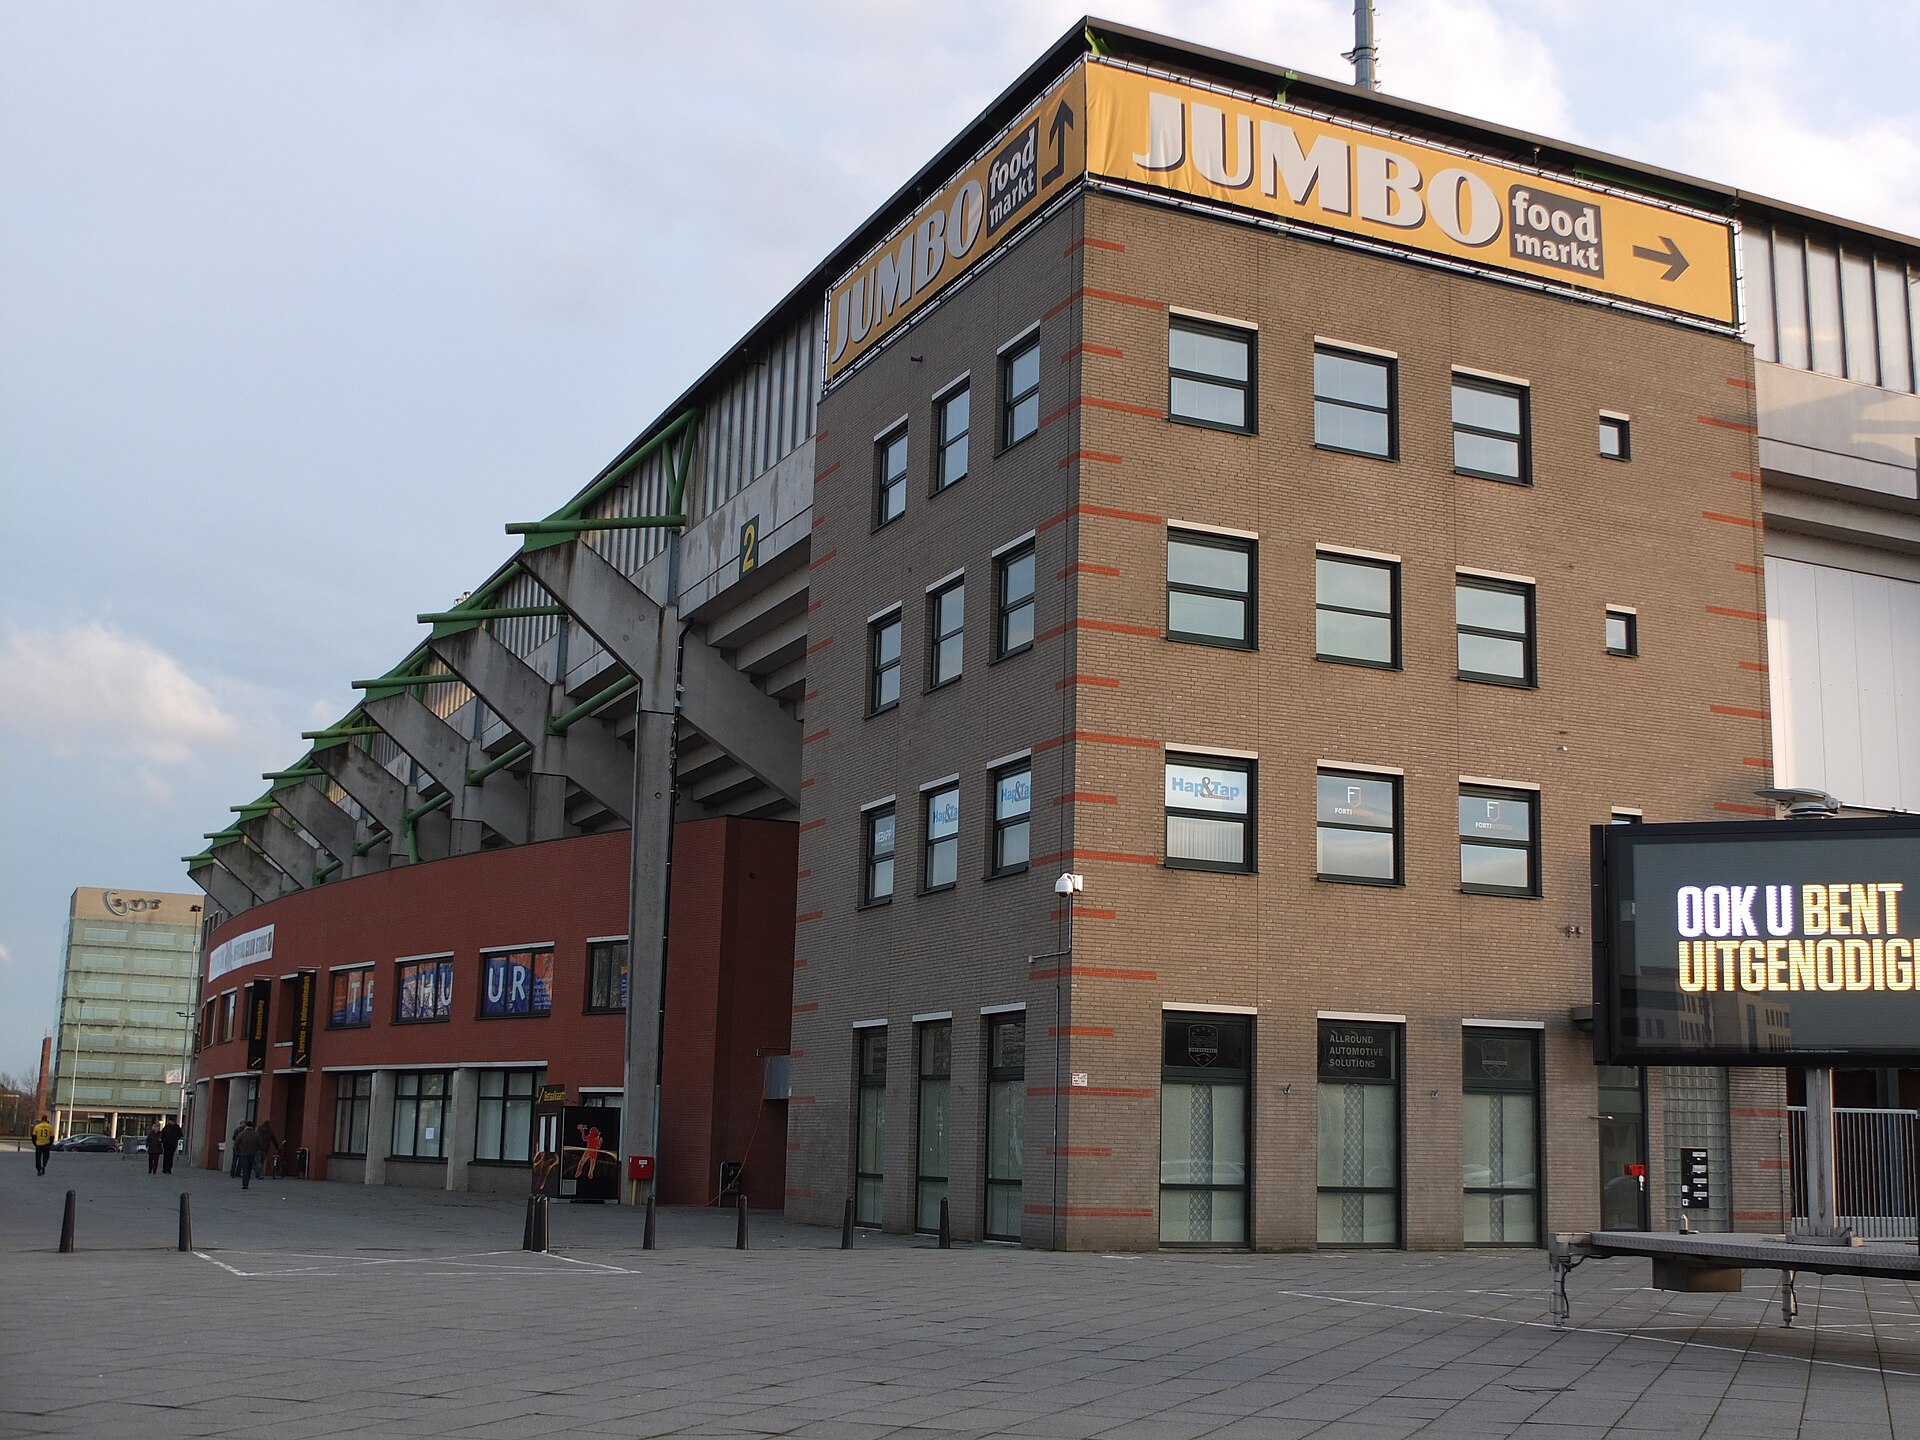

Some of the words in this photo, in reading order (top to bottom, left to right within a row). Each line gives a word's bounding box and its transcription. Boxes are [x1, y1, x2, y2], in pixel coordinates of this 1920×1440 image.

[990, 127, 1035, 200] food
[1132, 91, 1503, 247] JUMBO
[990, 168, 1034, 228] markt
[1512, 190, 1598, 244] food
[831, 179, 984, 363] JUMBO
[1514, 233, 1600, 271] markt
[742, 524, 755, 573] 2
[1001, 780, 1030, 803] Hap&Ta
[1171, 776, 1240, 801] Hap&Tap
[932, 803, 958, 824] Hap&Ta
[1677, 884, 1759, 938] OOK
[1765, 884, 1795, 937] U
[1802, 883, 1904, 936] BENT
[1677, 938, 1920, 992] UITGENODIG
[1329, 1034, 1375, 1045] ALLROUND
[1329, 1046, 1385, 1057] AUTOMOTIVE
[1329, 1058, 1376, 1069] SOLUTIONS
